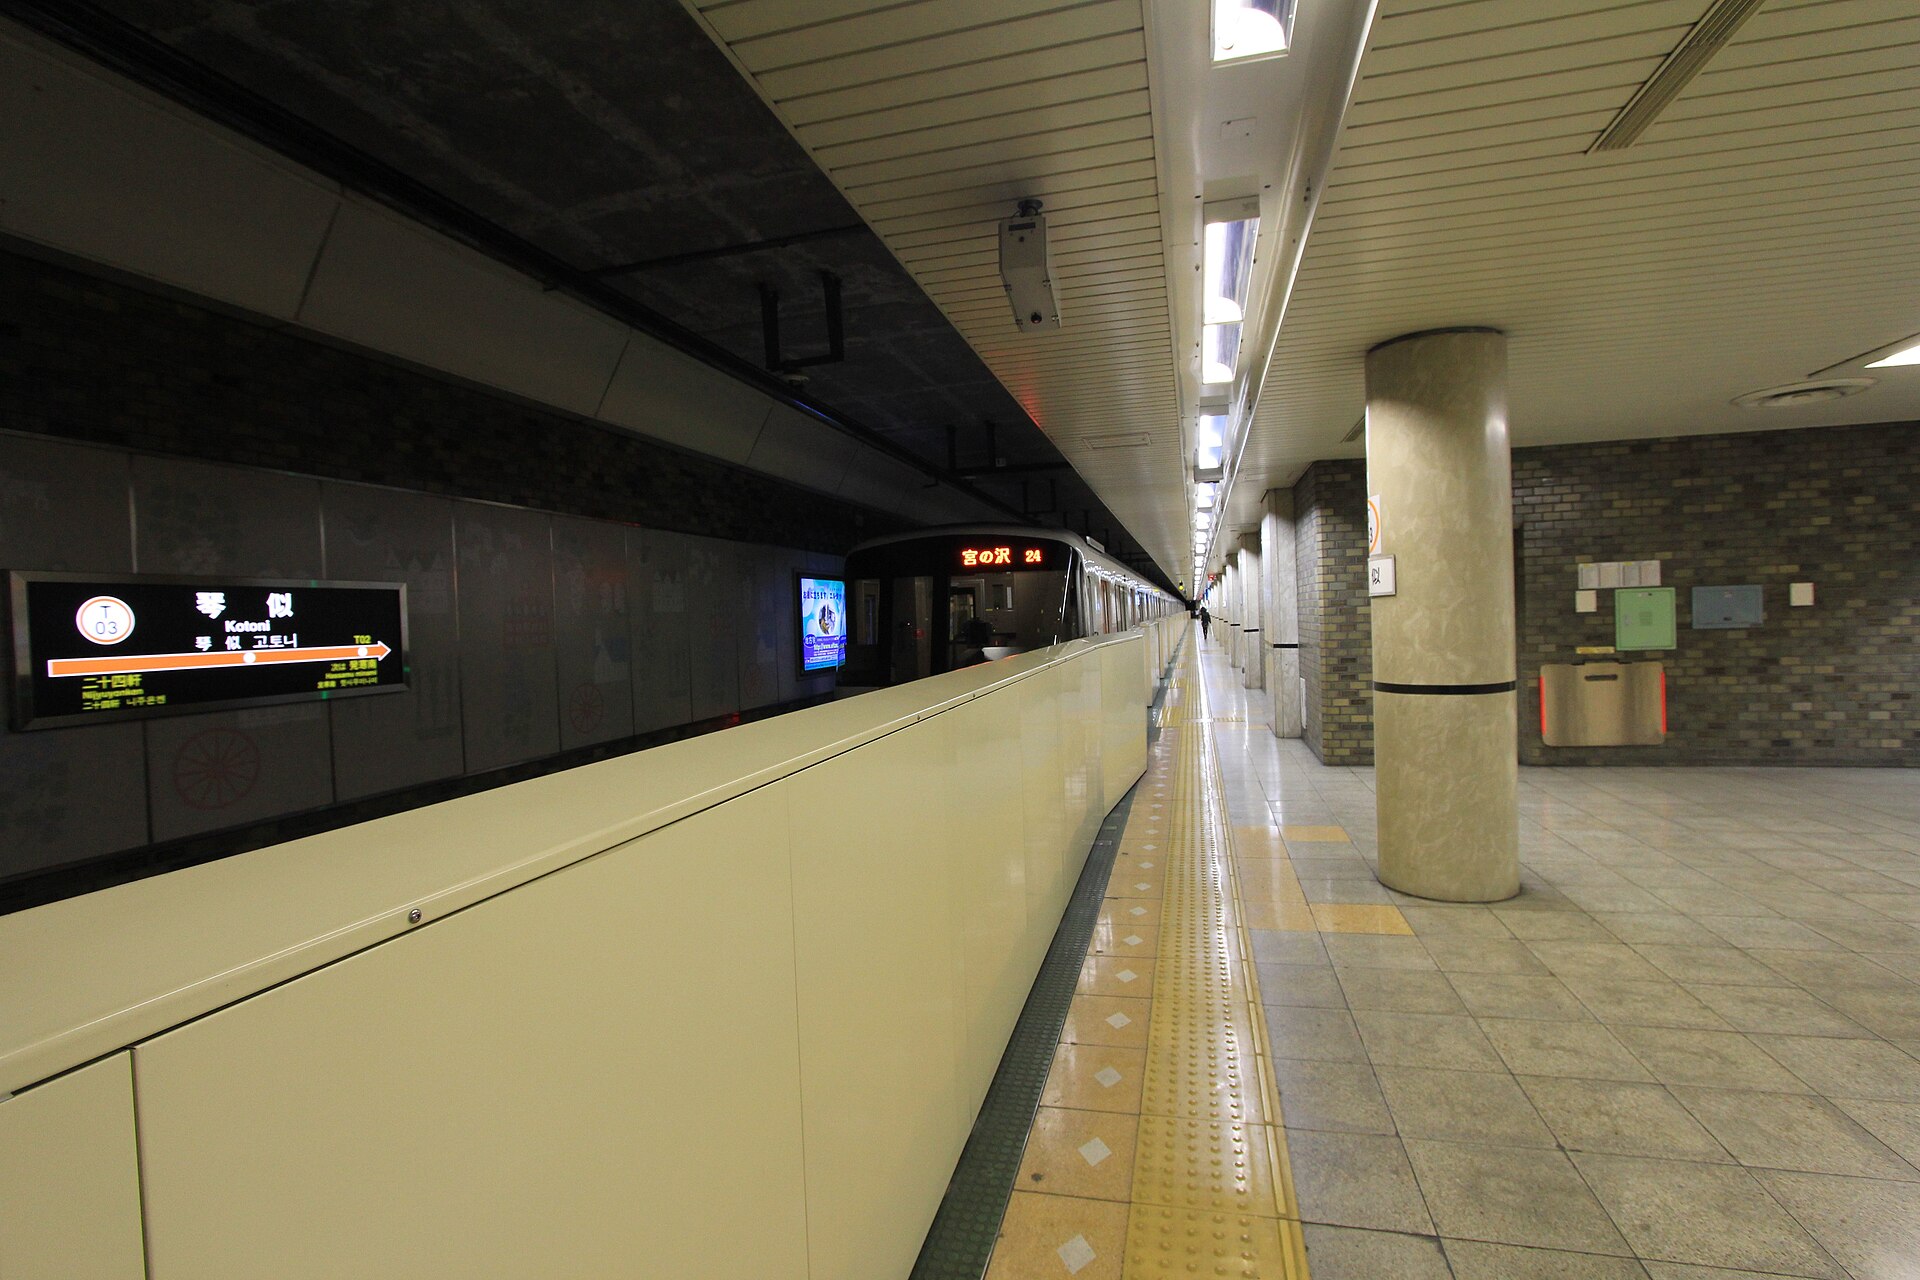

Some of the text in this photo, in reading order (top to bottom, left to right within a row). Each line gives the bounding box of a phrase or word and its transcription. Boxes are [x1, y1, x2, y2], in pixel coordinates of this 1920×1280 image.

[962, 547, 1042, 566] 宮の沢 24
[99, 605, 112, 619] T
[95, 621, 118, 635] 03
[224, 619, 271, 632] Kotoni
[252, 632, 298, 649] 고토니
[353, 634, 372, 645] T02
